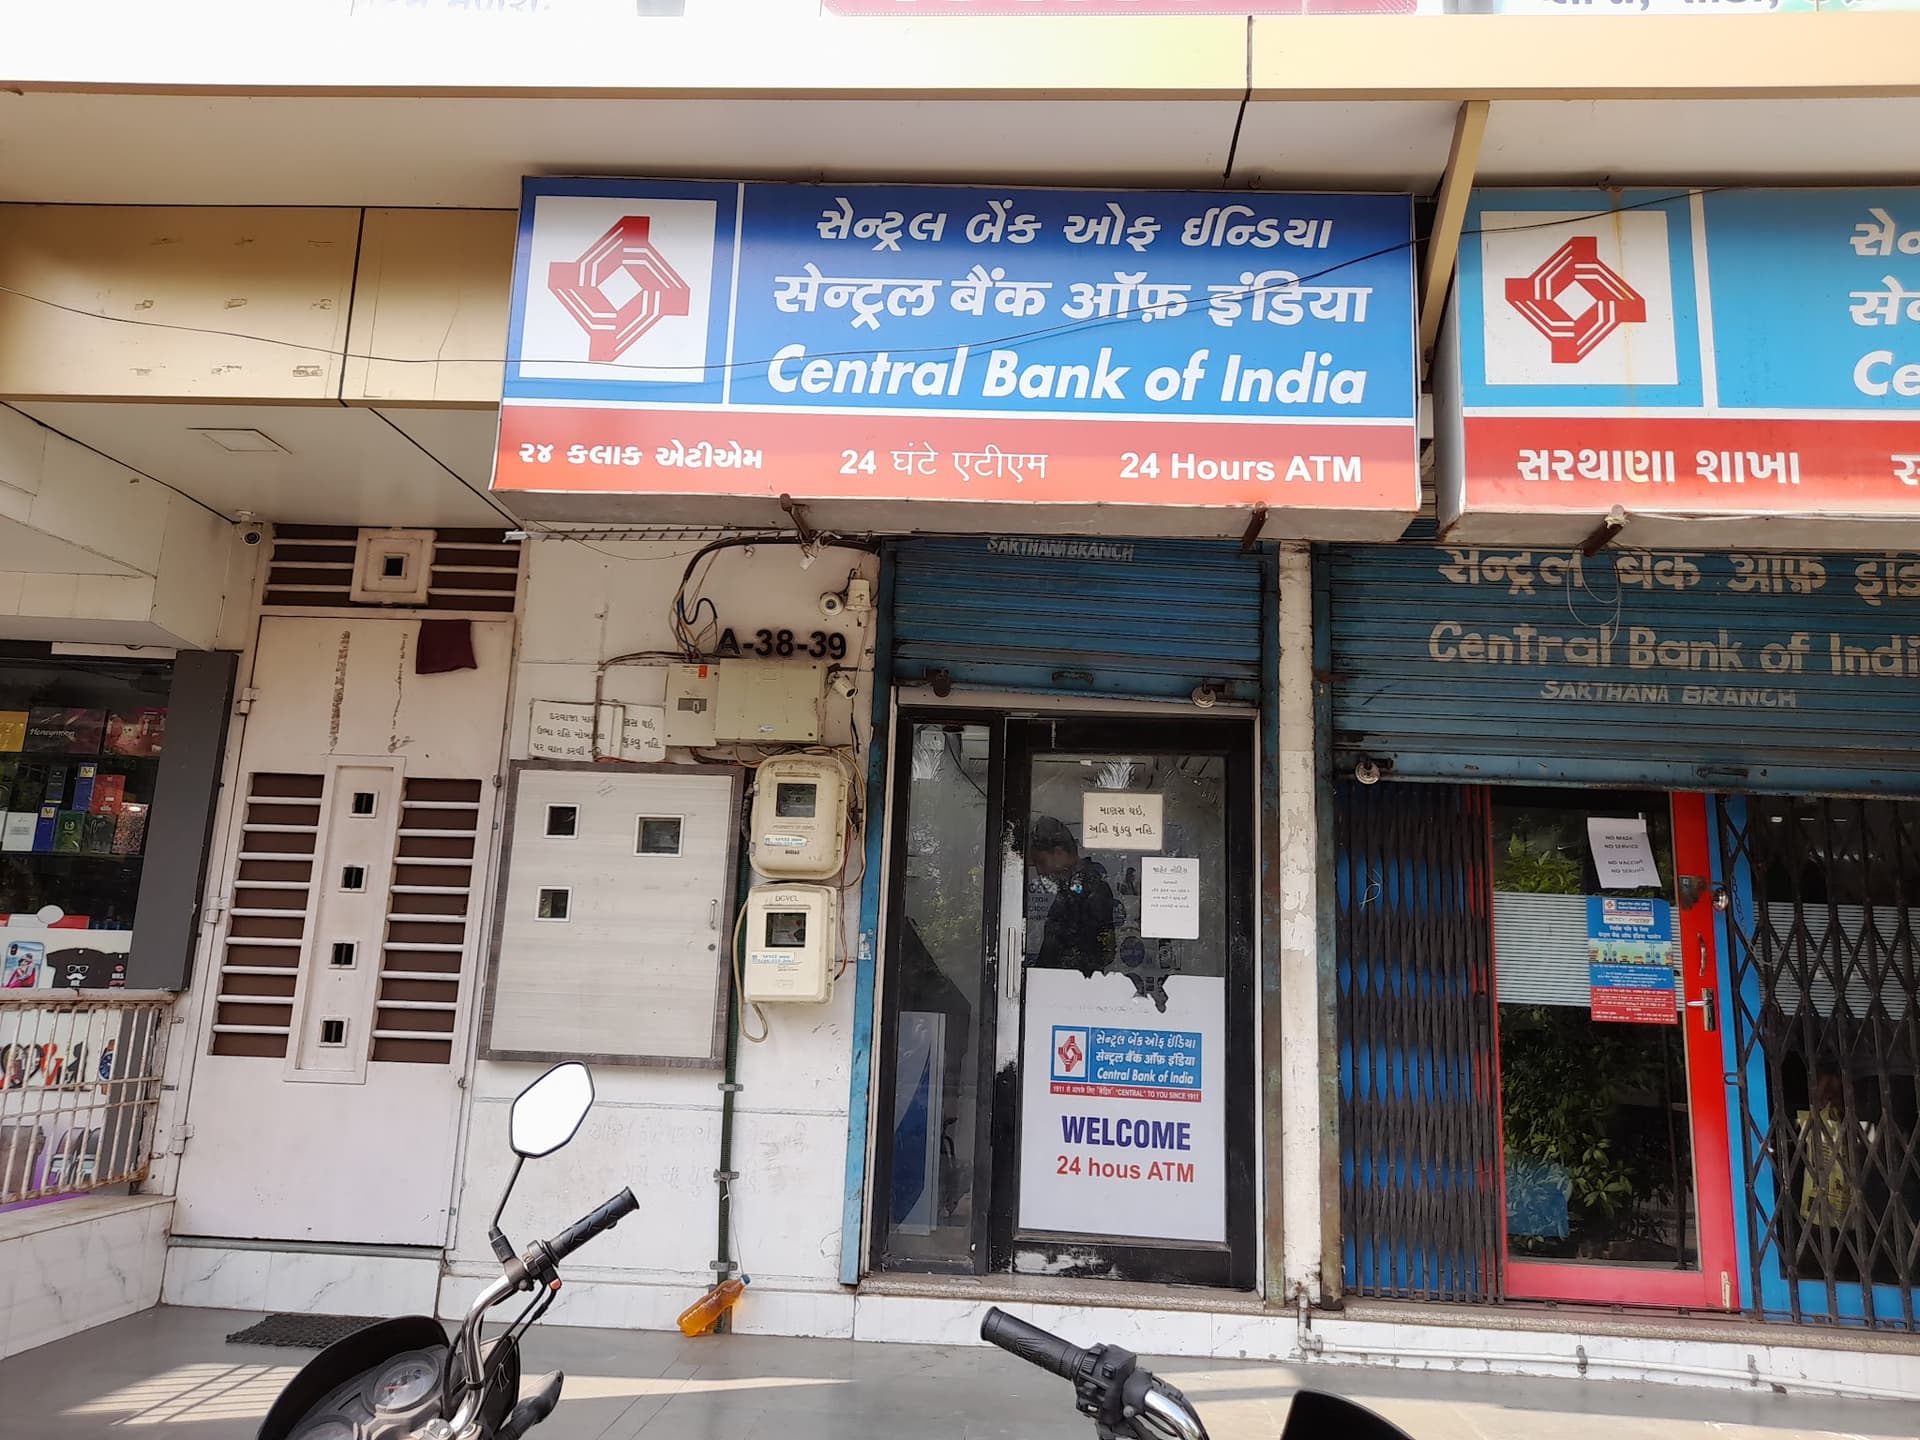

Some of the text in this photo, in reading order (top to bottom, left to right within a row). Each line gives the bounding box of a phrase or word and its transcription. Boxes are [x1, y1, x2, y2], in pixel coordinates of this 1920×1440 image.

[816, 197, 948, 252] સેન્ટ્રલ
[965, 199, 1043, 245] બેંક
[1063, 203, 1161, 252] ઓફ
[773, 262, 942, 331] सेन्ट्रल
[950, 264, 1053, 318] बैंक
[1207, 270, 1374, 328] इंडिया
[767, 344, 1368, 405] Central Bank of India
[566, 443, 643, 466] કલાક
[655, 439, 763, 469] એટીએમ
[839, 441, 1048, 483] 24 घंटे एटीएम
[1119, 452, 1362, 483] 24 Hours ATM
[1517, 448, 1801, 485] સરથાણા શાખા
[716, 628, 847, 660] A-38-39
[1428, 620, 1611, 668] Central
[1628, 625, 1746, 672] Bank
[1759, 631, 1810, 673] of
[1540, 680, 1797, 708] SARTHANA BRANCH
[1097, 1067, 1194, 1084] Central Bank of India
[1156, 1090, 1168, 1098] YOU
[1061, 1115, 1191, 1151] WELCOME
[1056, 1155, 1194, 1183] 24 hous ATM
